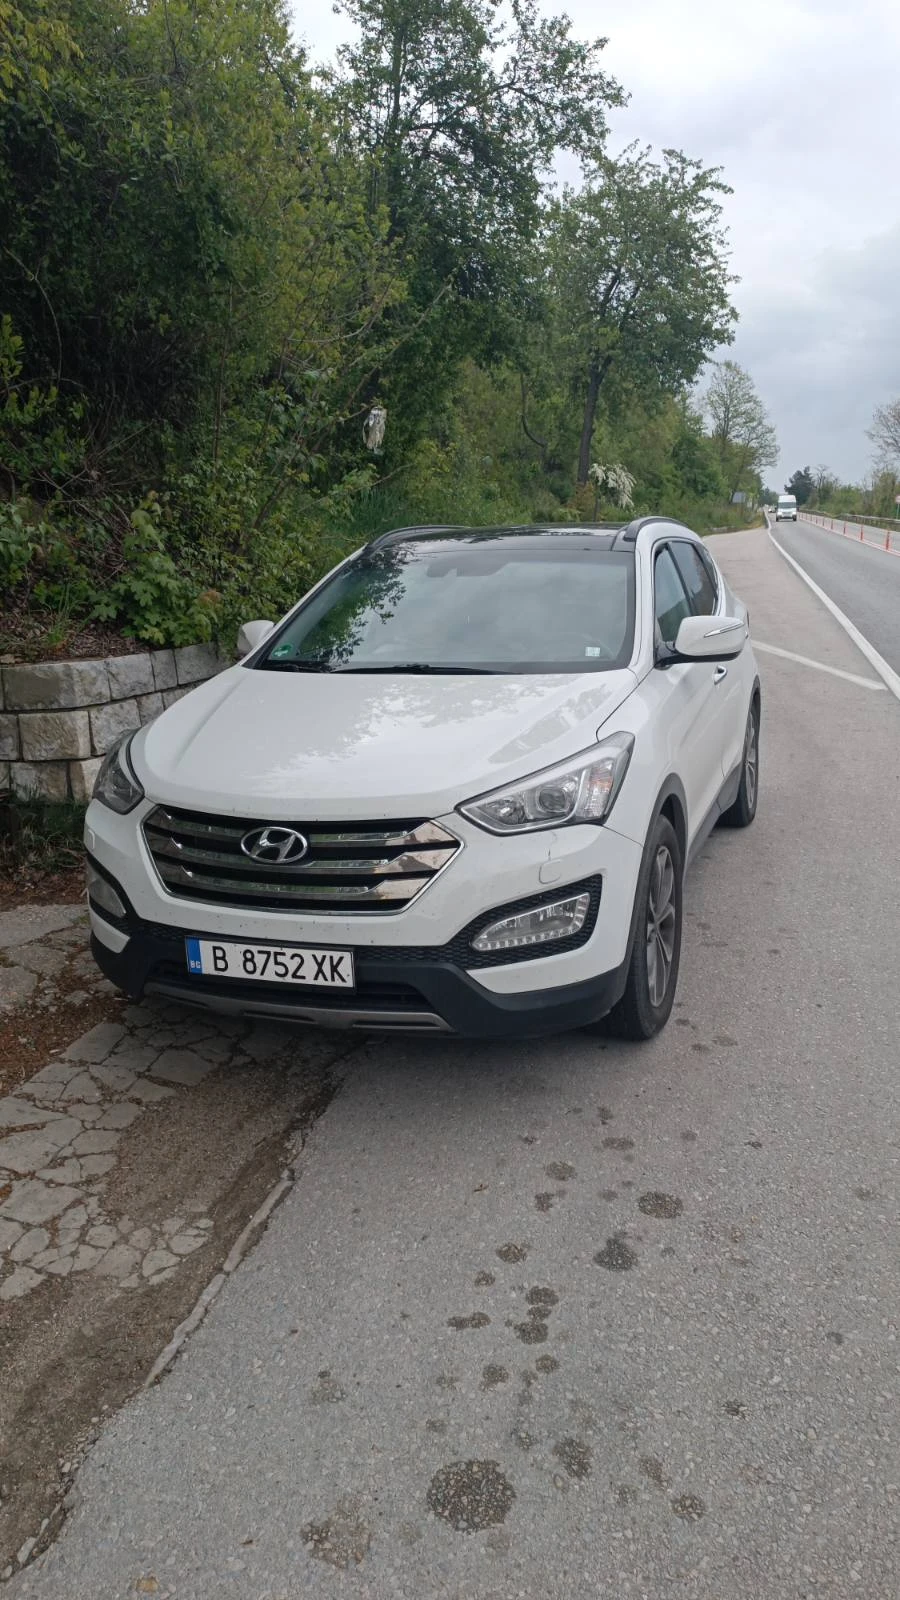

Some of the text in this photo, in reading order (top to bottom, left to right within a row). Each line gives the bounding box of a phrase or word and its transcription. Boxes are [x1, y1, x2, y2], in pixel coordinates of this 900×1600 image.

[212, 946, 347, 983] B 8752 XK
